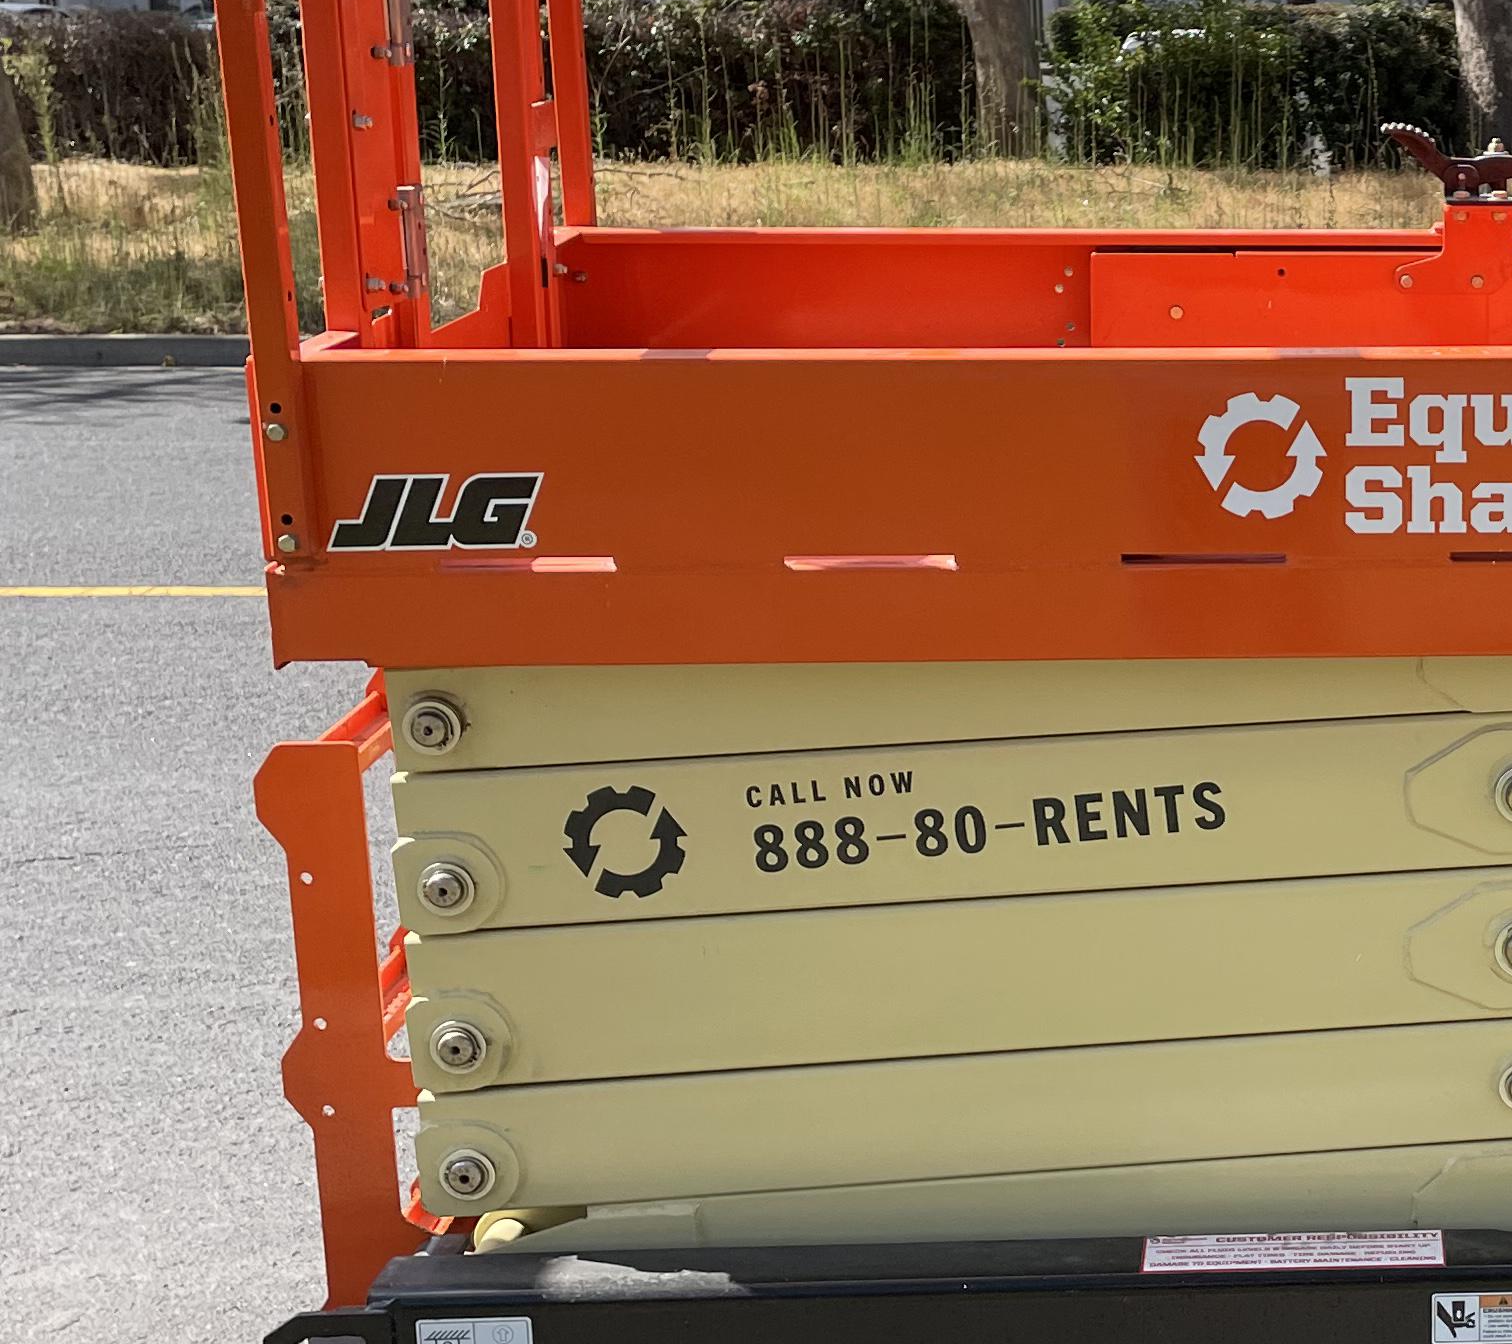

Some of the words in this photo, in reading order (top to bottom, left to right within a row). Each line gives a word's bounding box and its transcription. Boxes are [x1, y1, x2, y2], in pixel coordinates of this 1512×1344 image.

[328, 473, 544, 551] JLG
[746, 780, 828, 808] CALL
[844, 770, 913, 798] NOW
[1215, 1235, 1302, 1243] CUSTOMER
